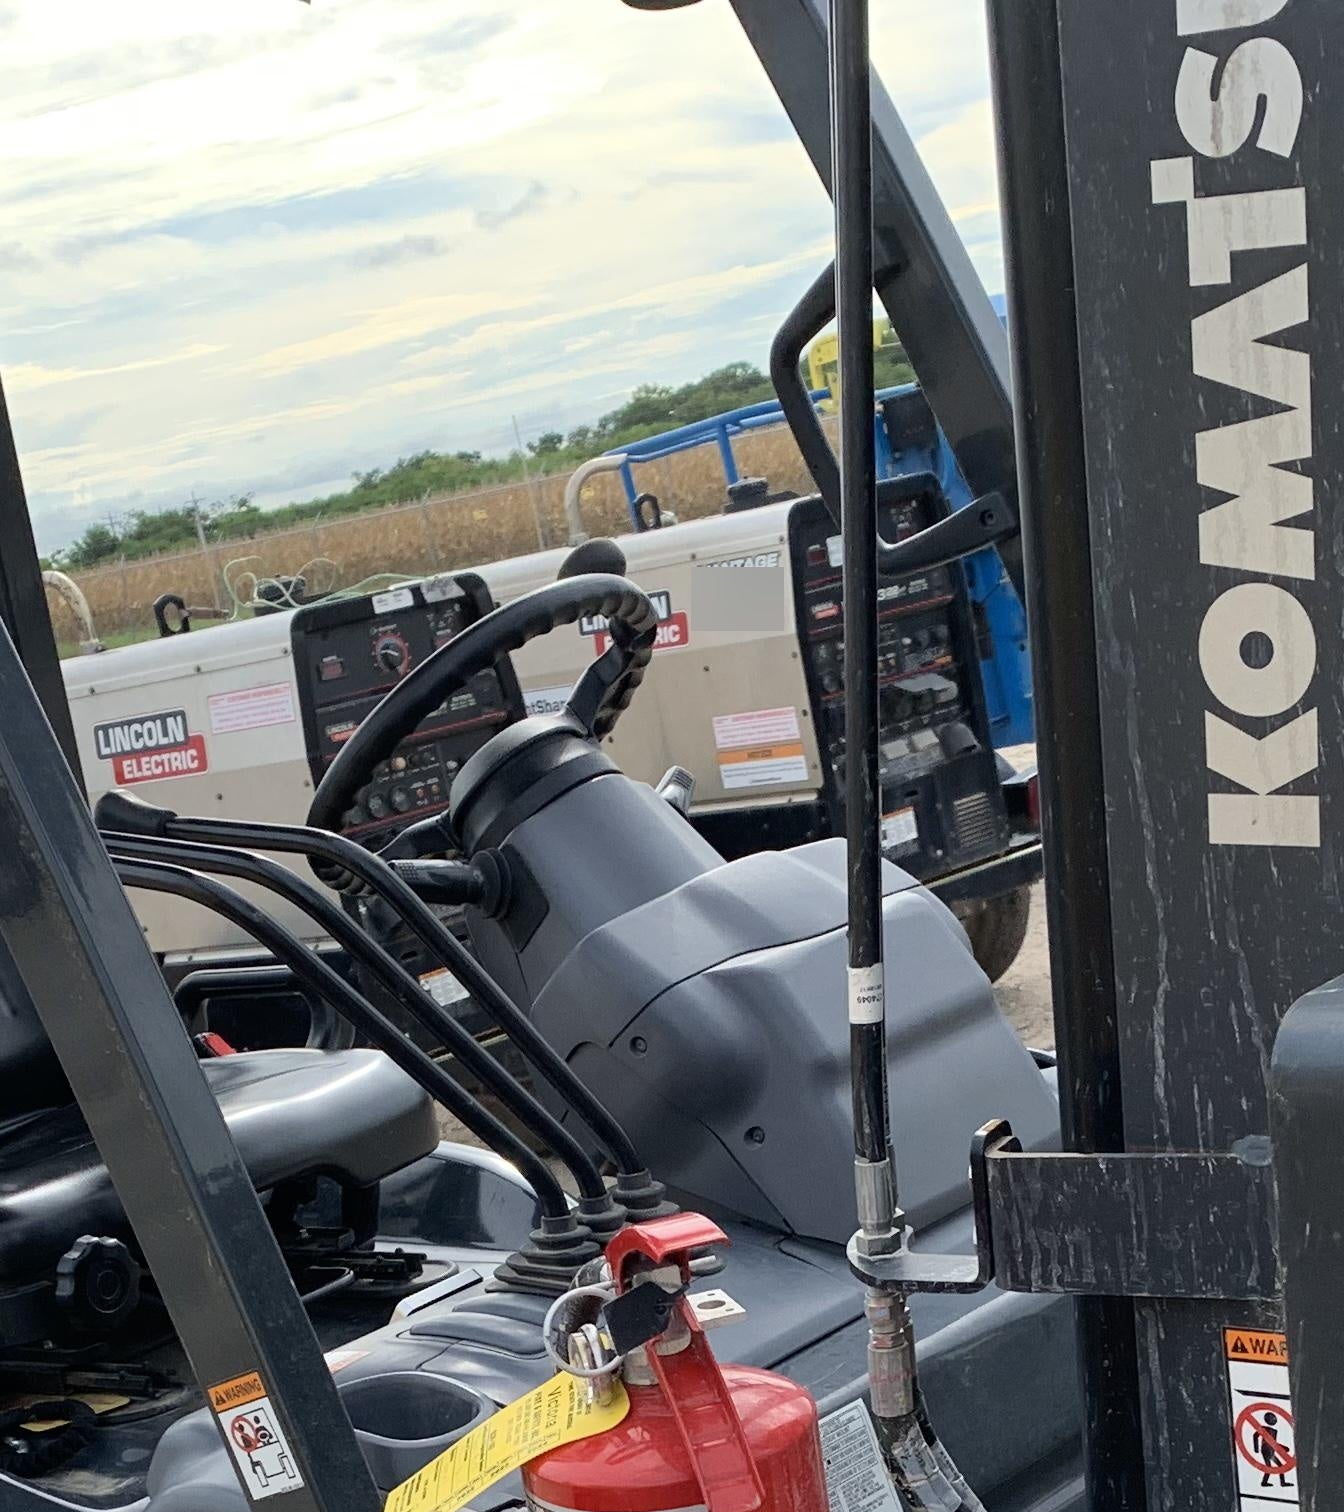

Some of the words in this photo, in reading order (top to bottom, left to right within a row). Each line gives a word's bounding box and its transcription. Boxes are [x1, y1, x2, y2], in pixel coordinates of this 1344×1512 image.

[1150, 0, 1321, 847] KOMATS
[98, 715, 185, 756] LINCOLN
[122, 748, 199, 780] ELECTRIC
[223, 1378, 262, 1402] WARNING
